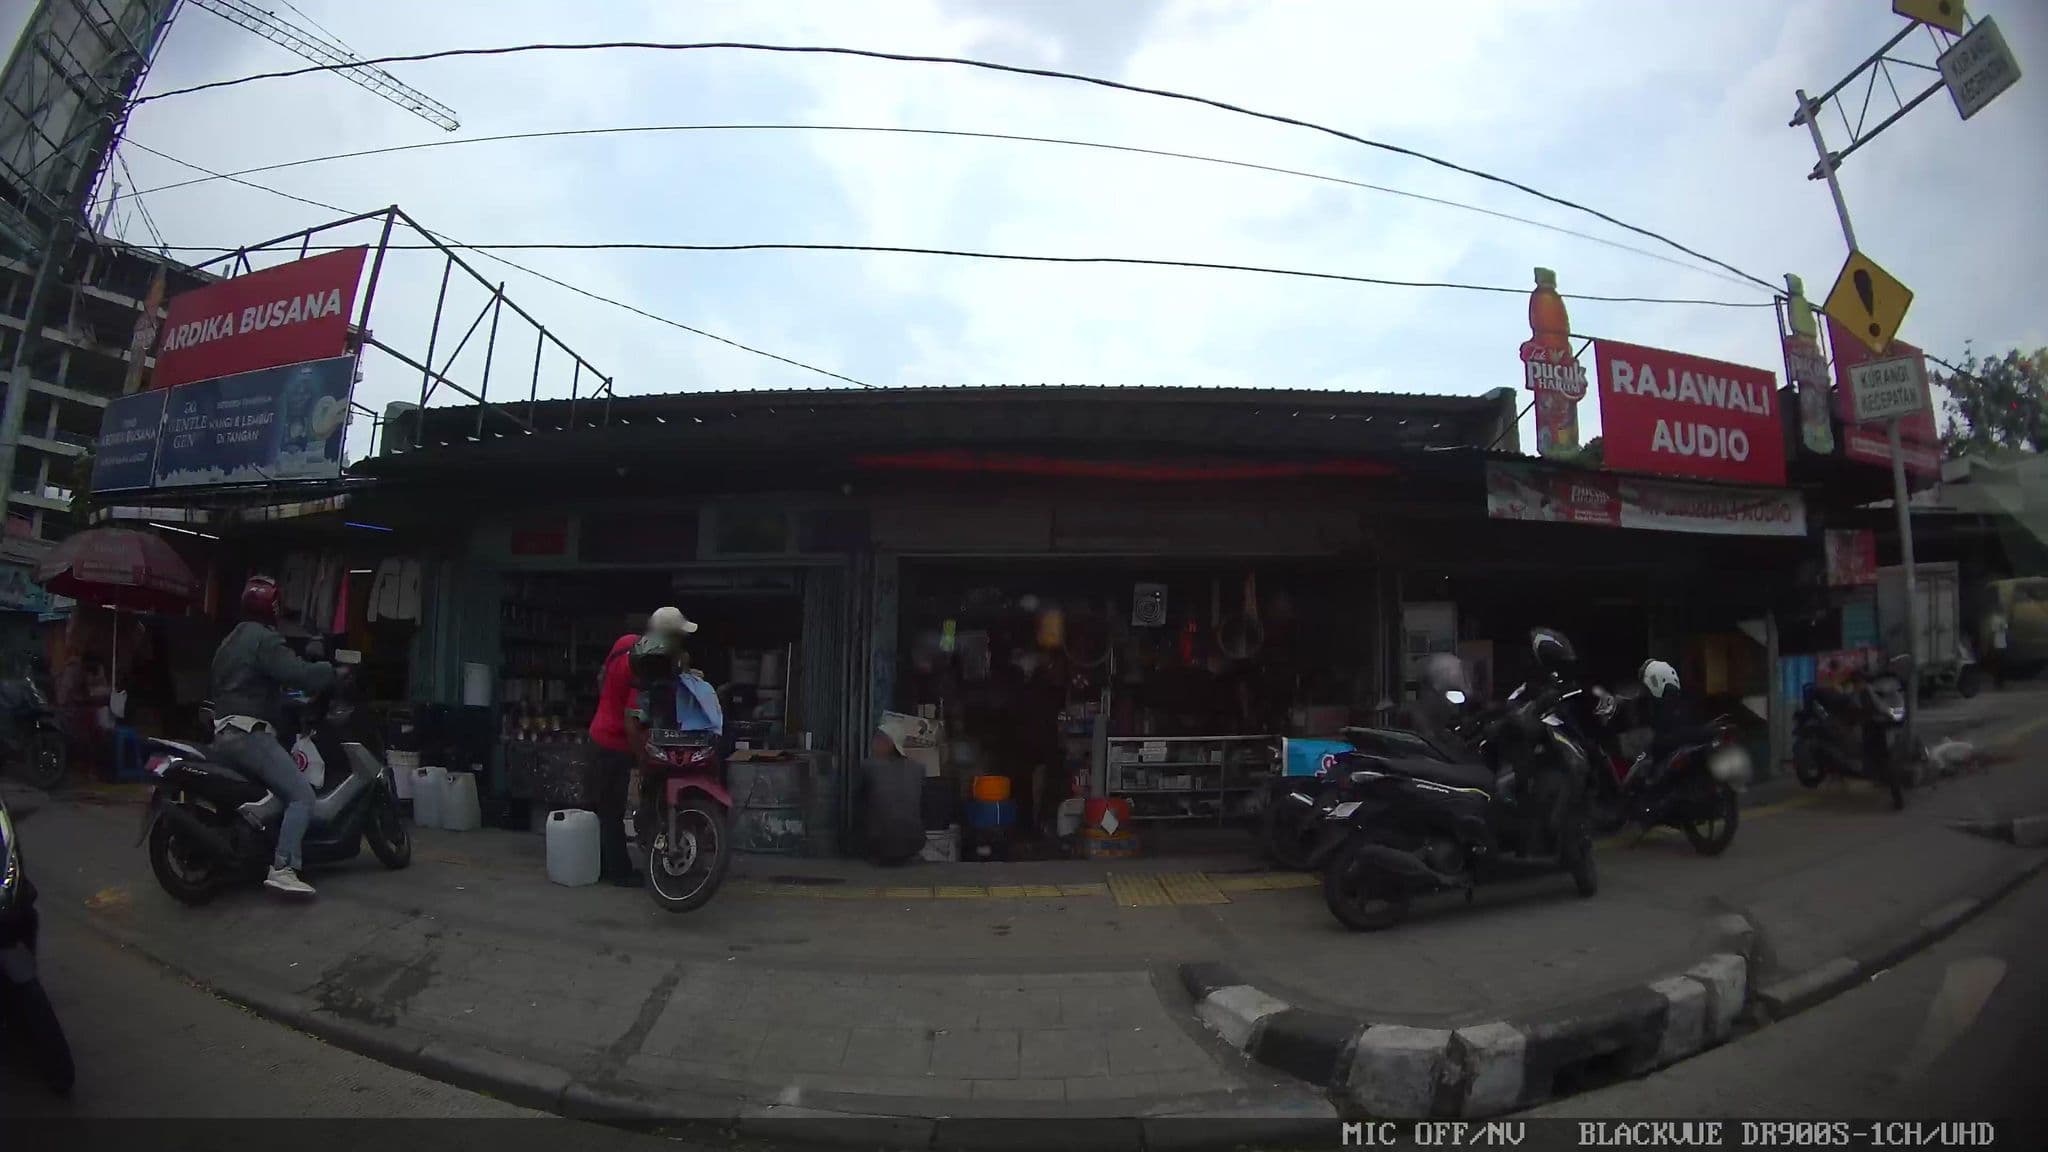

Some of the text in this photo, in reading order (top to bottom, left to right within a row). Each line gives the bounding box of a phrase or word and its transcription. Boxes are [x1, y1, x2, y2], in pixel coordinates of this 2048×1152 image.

[163, 311, 234, 351] ARDIKA
[238, 288, 341, 334] BUSANA
[1526, 360, 1588, 388] pucuk
[1610, 359, 1770, 416] RAJAWALI
[1650, 418, 1749, 462] AUDIO
